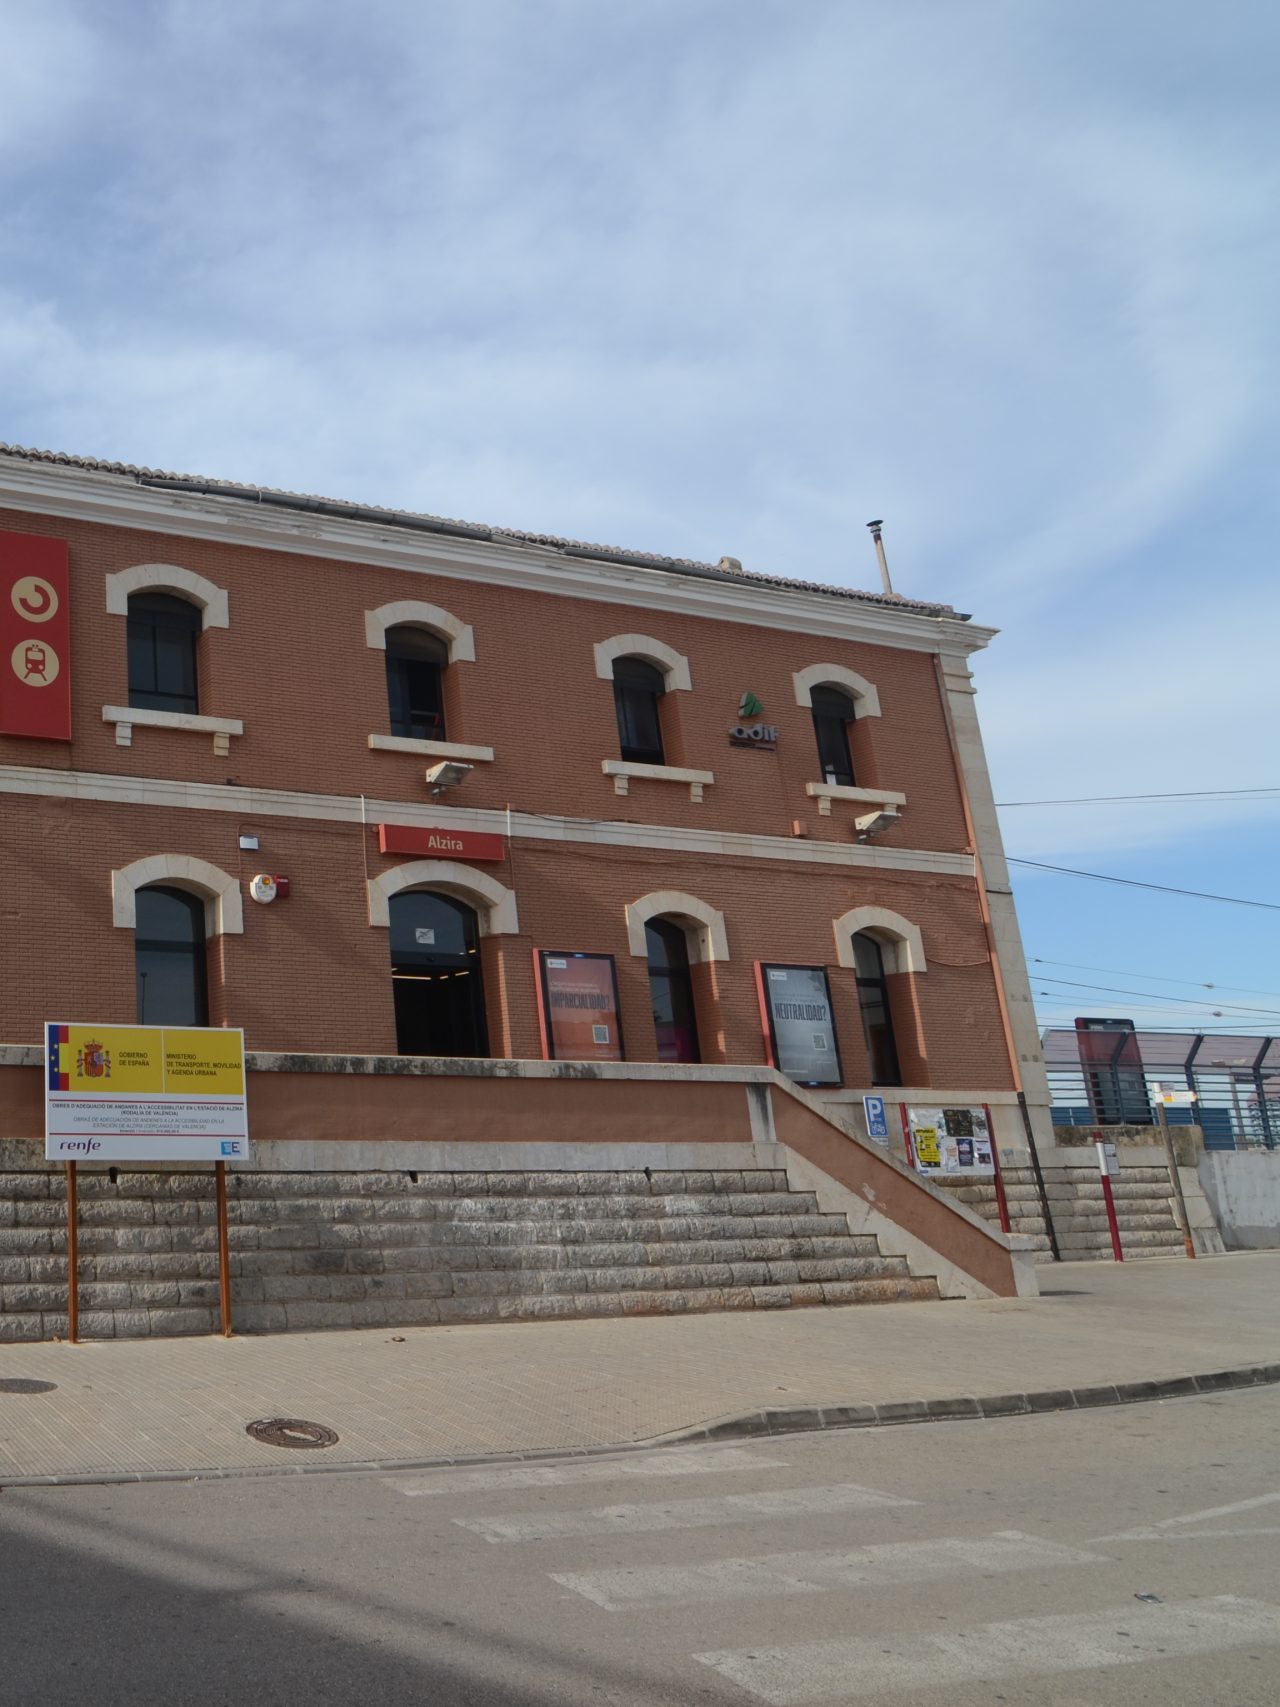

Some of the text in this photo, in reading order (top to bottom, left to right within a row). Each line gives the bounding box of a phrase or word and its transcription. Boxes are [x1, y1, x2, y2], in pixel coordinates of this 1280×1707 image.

[428, 834, 464, 851] Alzira
[550, 990, 610, 1011] IMPARCIALIDAD?
[774, 1002, 827, 1022] NEUTRALIDAD?
[867, 1099, 882, 1122] P
[59, 1137, 102, 1155] renfe
